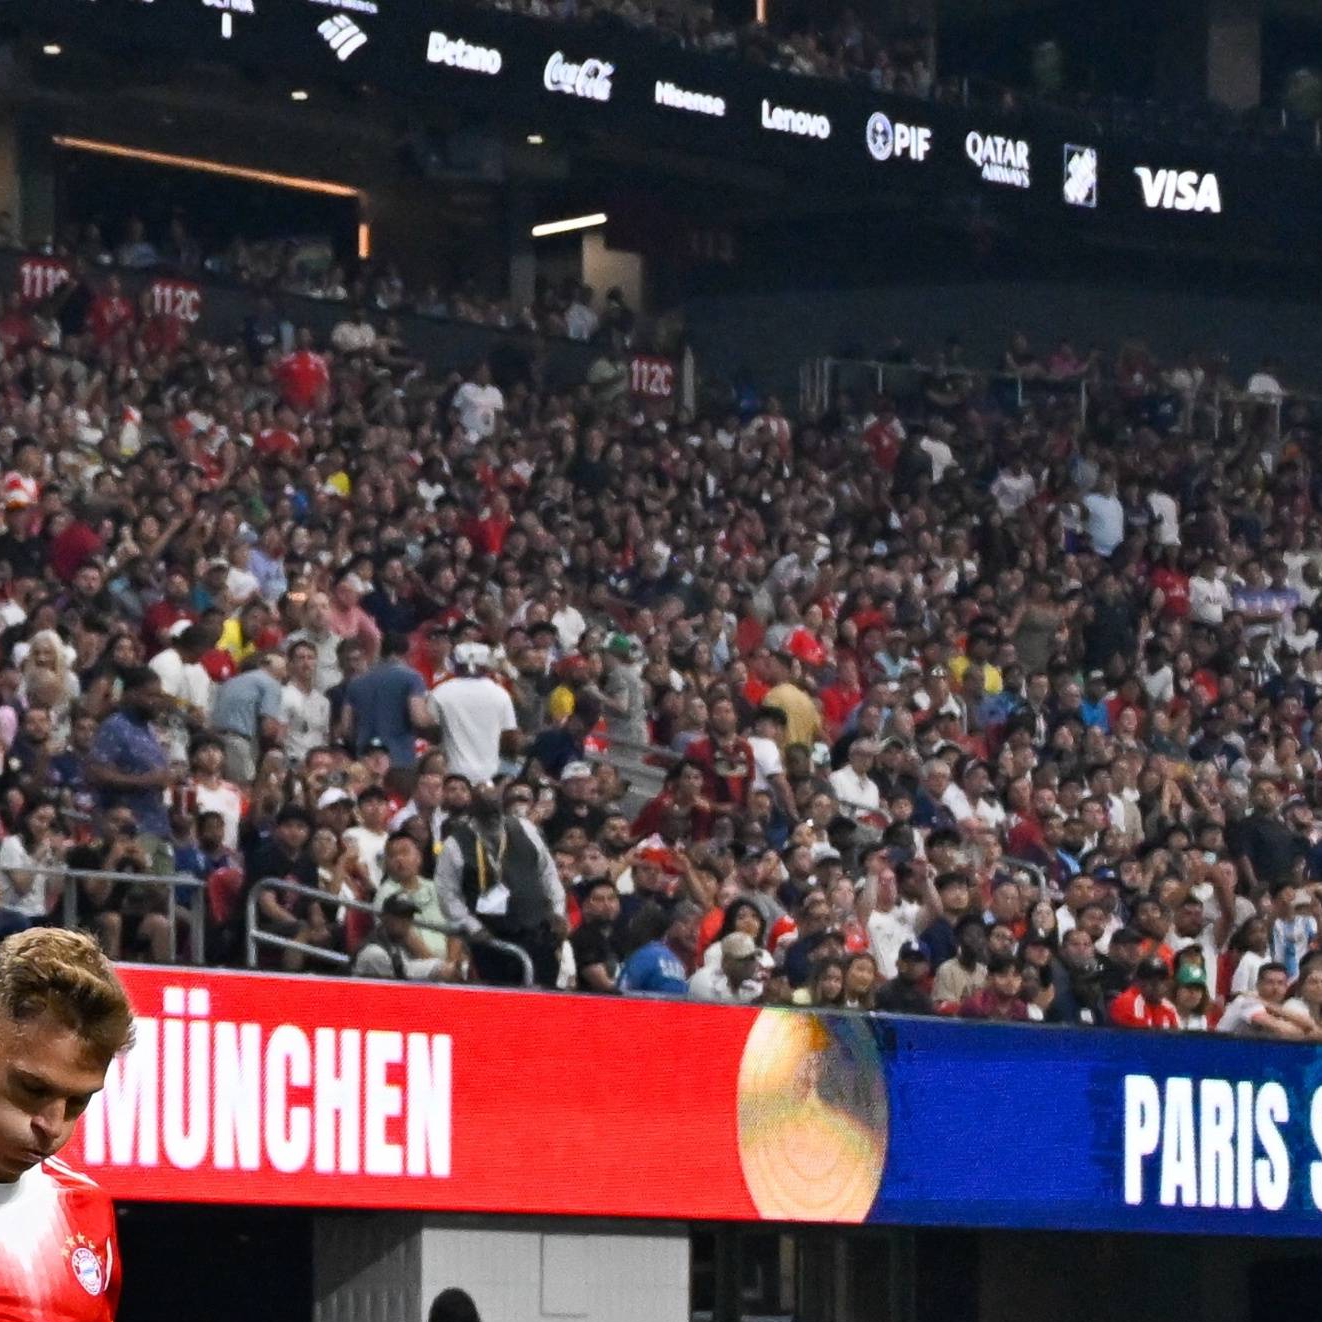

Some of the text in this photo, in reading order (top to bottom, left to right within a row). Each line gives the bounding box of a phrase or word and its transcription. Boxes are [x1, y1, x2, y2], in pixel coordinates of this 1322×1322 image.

[654, 80, 726, 117] Hisense
[761, 98, 831, 140] Lenovo
[895, 123, 932, 162] PIF
[965, 130, 1030, 170] QATAR
[1133, 166, 1222, 213] VISA
[84, 987, 453, 1178] MÜNCHEN
[1124, 1074, 1290, 1208] PARIS
